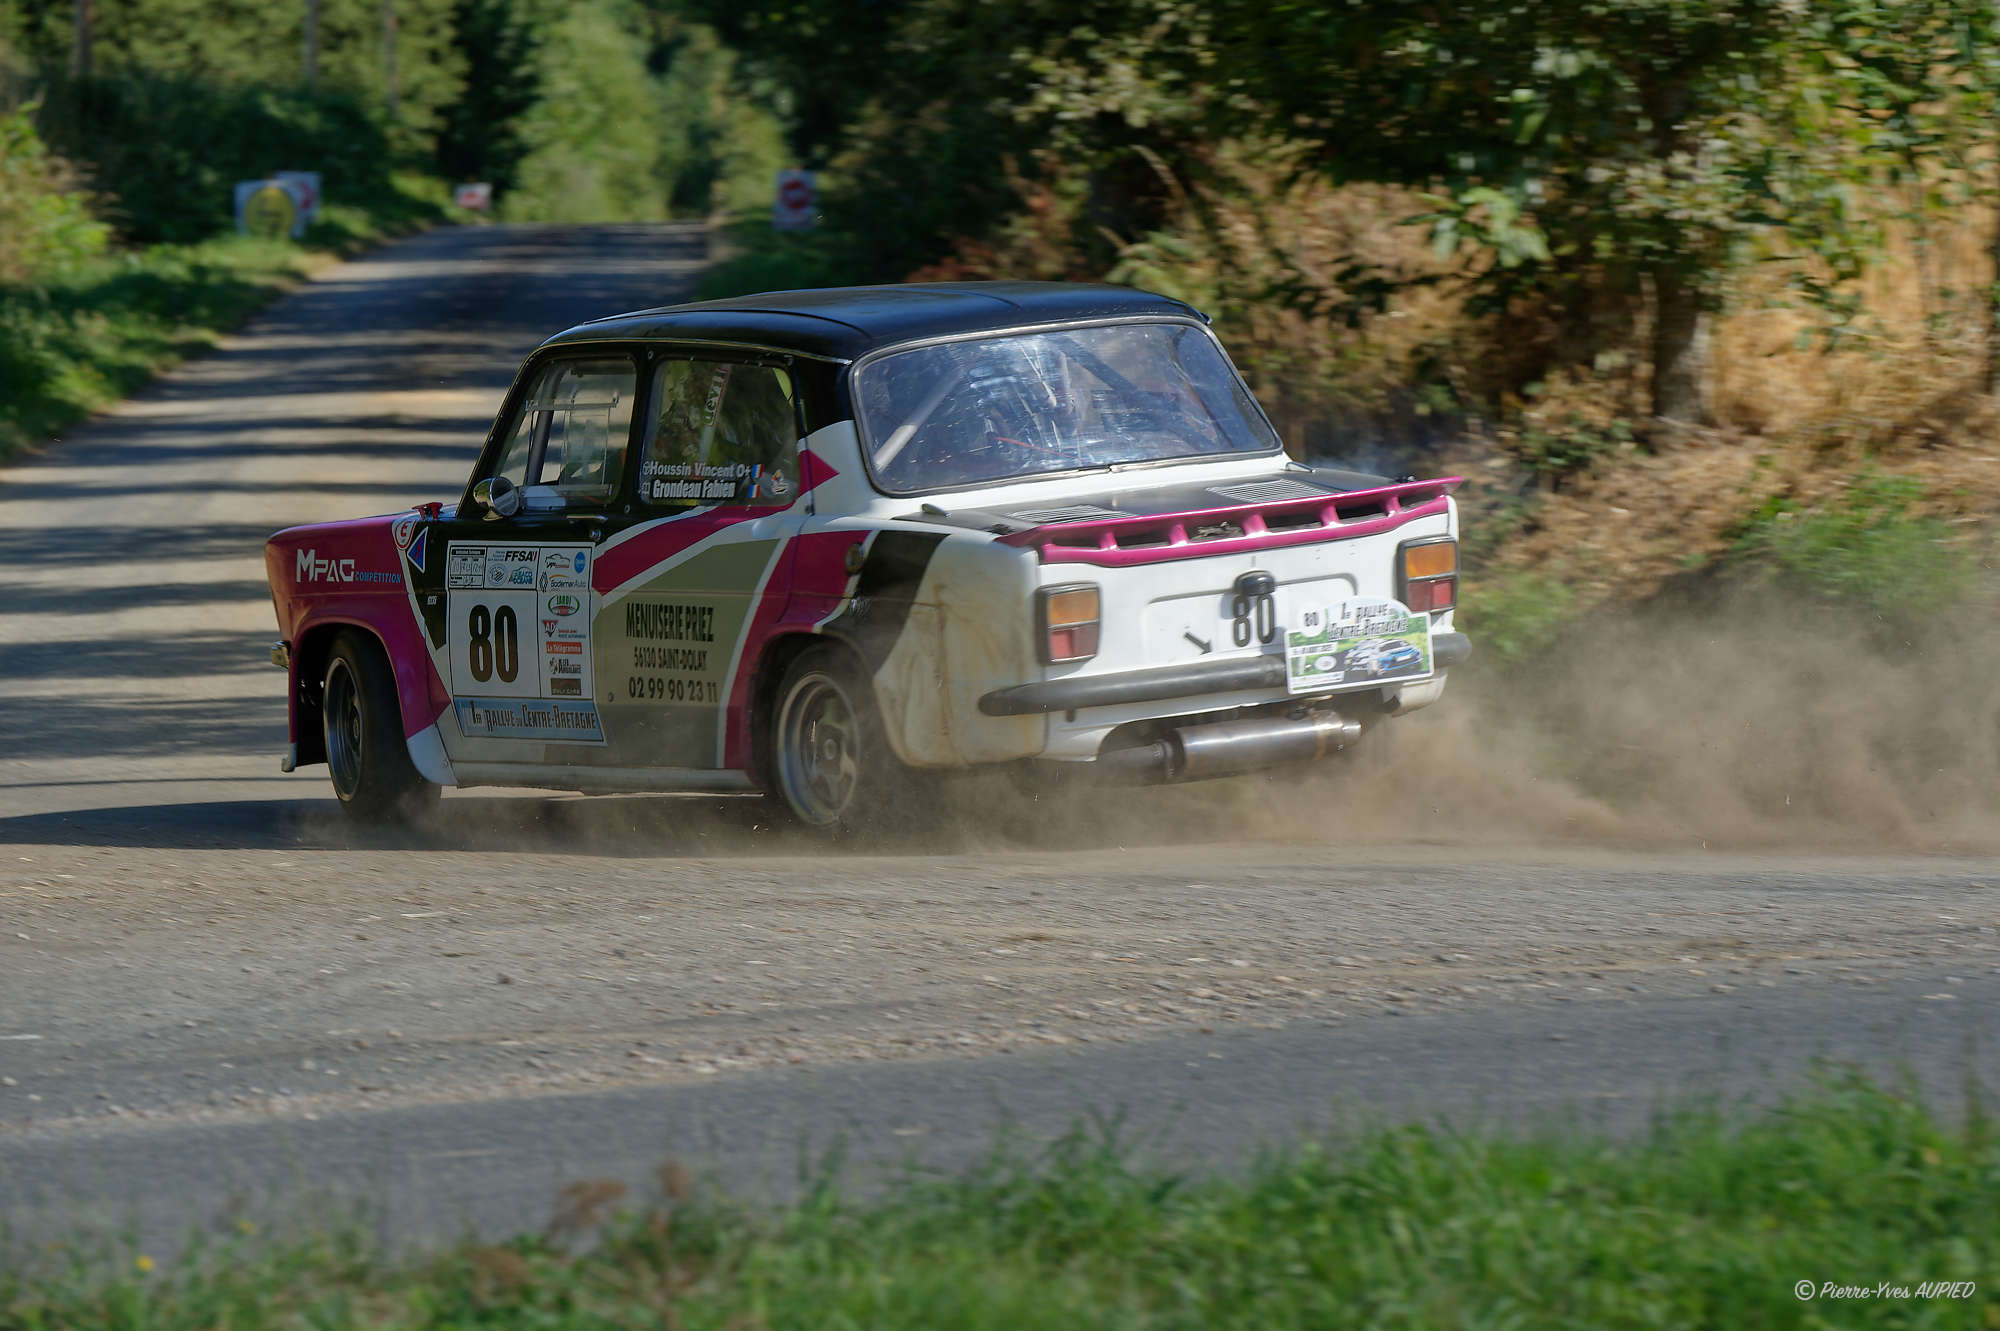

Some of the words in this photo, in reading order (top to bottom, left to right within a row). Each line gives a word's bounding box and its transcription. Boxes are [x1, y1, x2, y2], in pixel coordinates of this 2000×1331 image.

[651, 461, 691, 476] Houssin
[694, 462, 734, 478] Vincent
[652, 480, 701, 499] Grondeau
[702, 480, 736, 499] Fabien
[504, 550, 534, 562] FFSA
[355, 571, 401, 584] COMPETITION
[626, 602, 684, 641] MENUISERIE
[685, 605, 715, 643] PRIEZ
[1233, 594, 1274, 648] 80
[1304, 612, 1319, 628] 80
[469, 604, 519, 683] 80
[629, 677, 645, 698] 02
[648, 678, 664, 700] 99
[668, 679, 684, 702] 90
[688, 680, 704, 702] 23
[706, 682, 718, 703] 11
[485, 709, 515, 733] RALLYE
[522, 703, 596, 729] CENTRE-BRETAGNE
